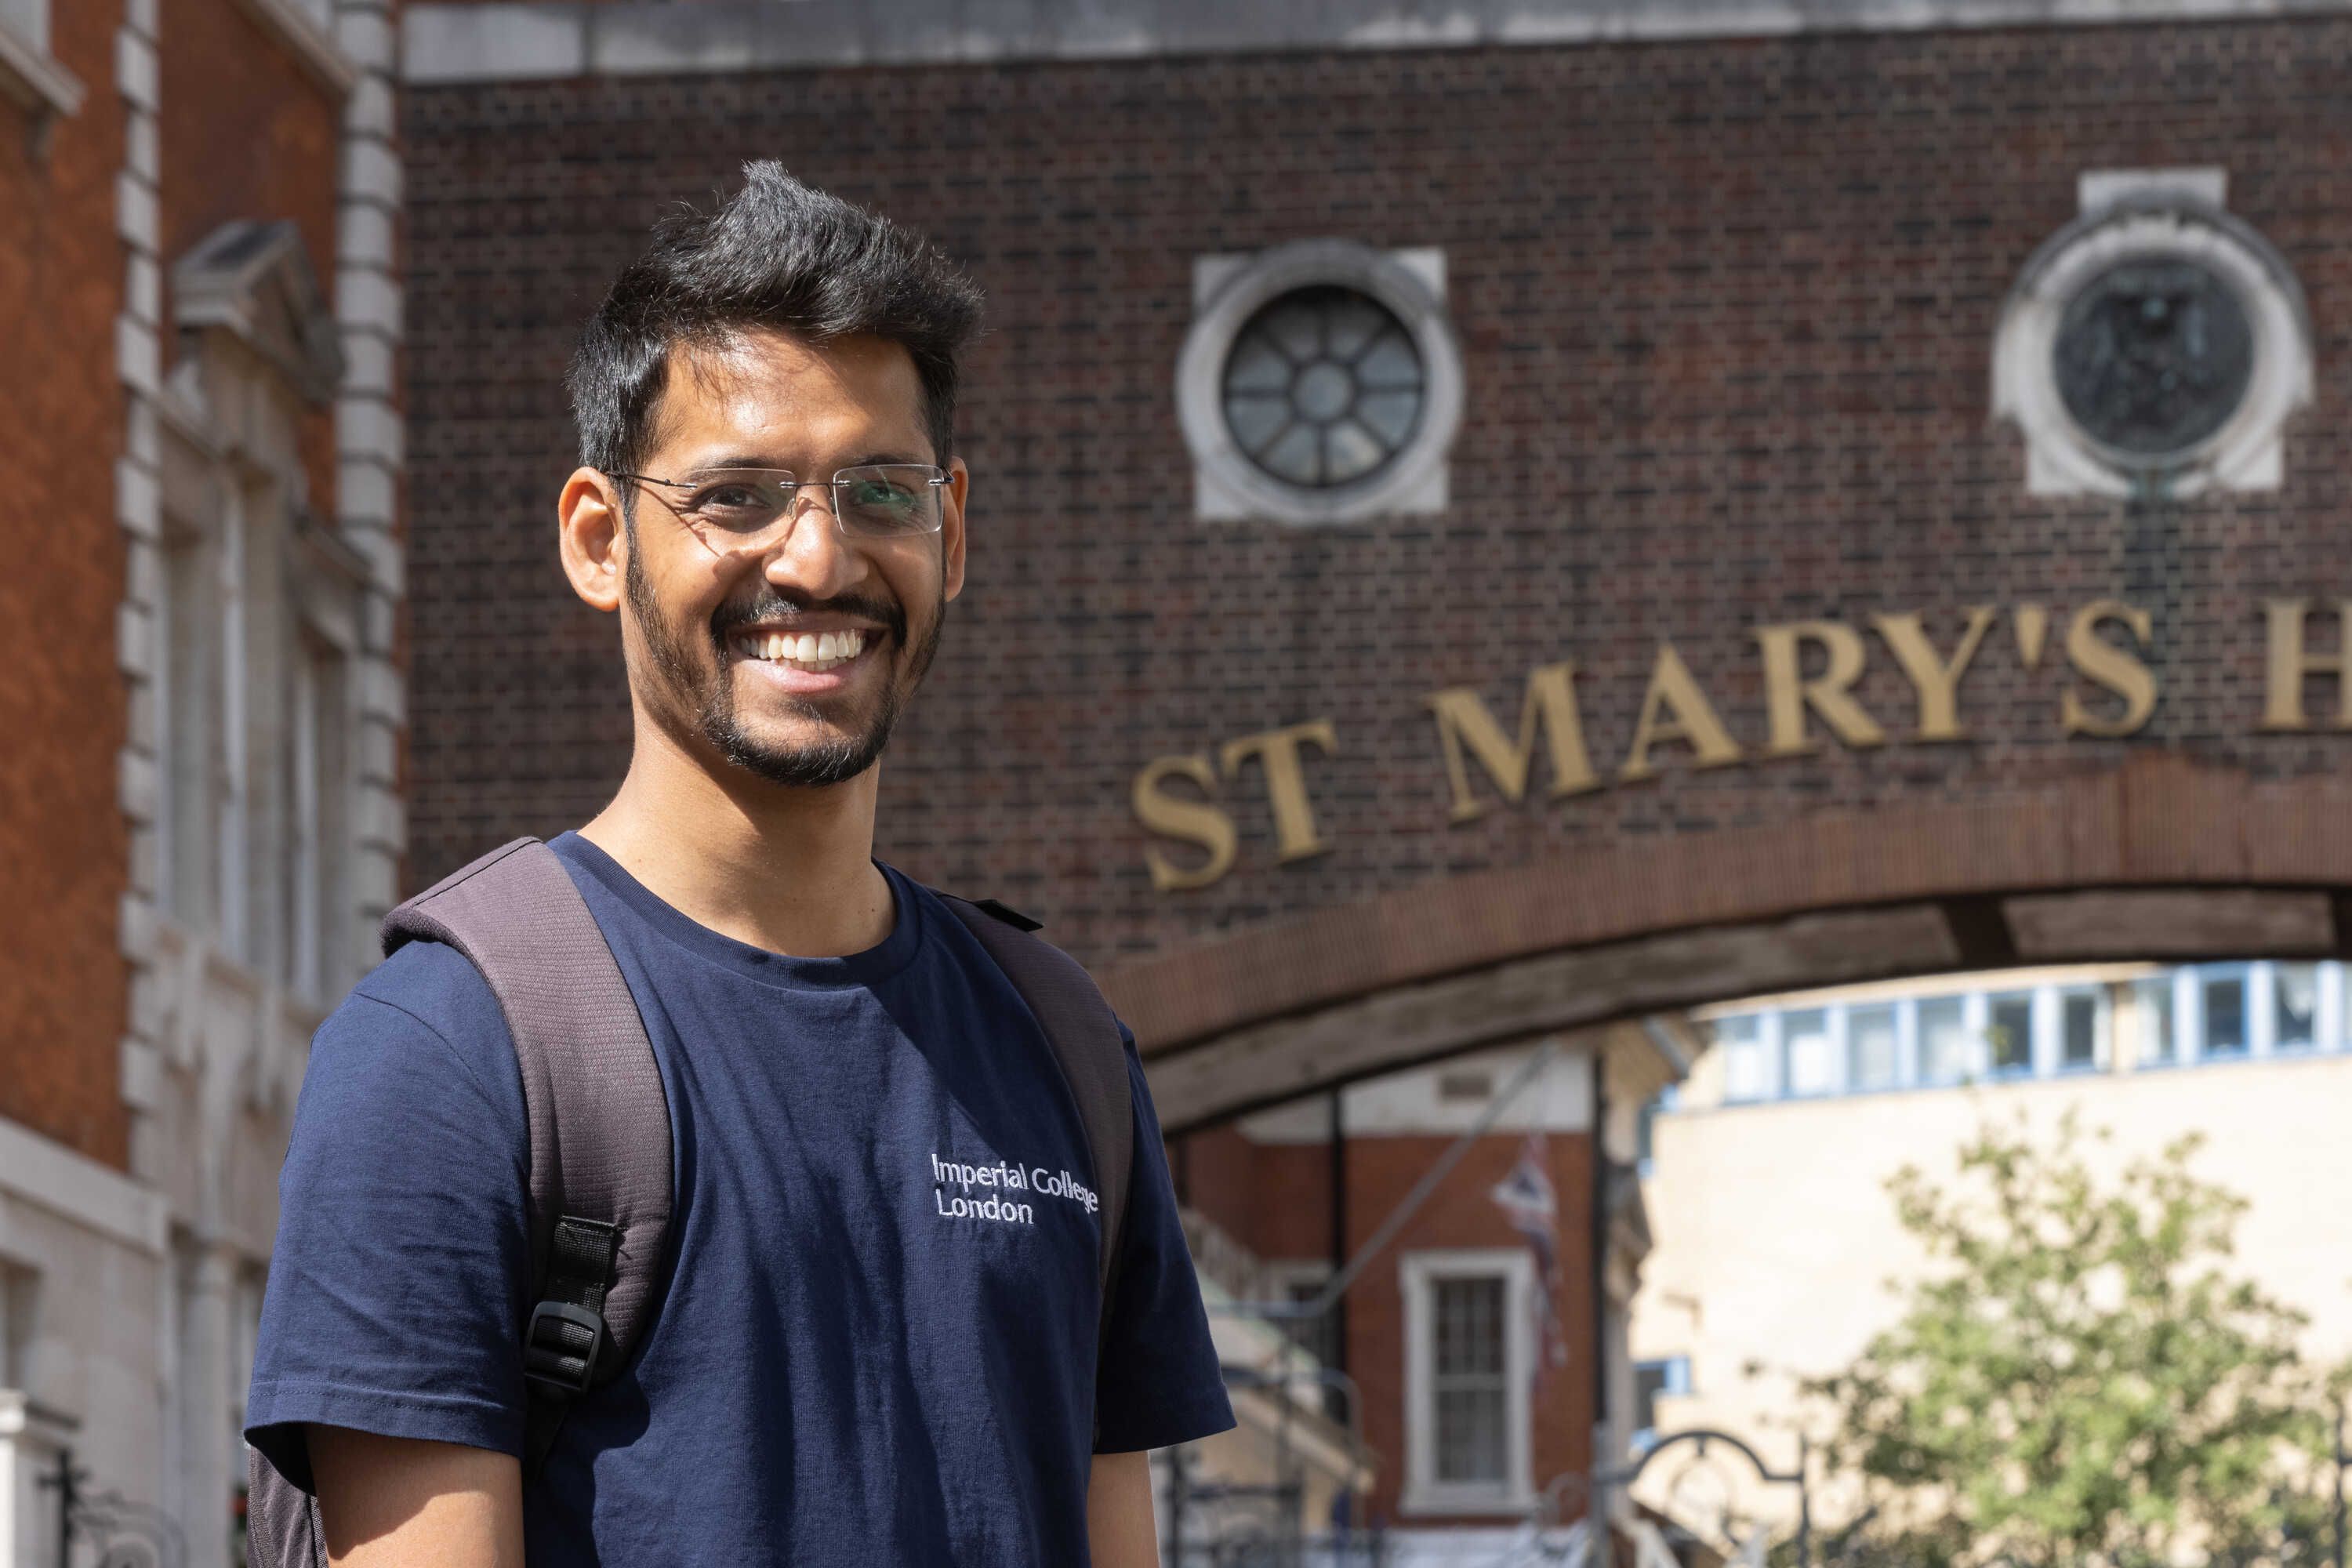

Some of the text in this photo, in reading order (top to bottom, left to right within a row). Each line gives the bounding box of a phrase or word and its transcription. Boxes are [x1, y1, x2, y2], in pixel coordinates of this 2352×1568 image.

[1131, 717, 1337, 891] ST
[1427, 599, 2158, 822] MARY'S
[931, 1153, 1098, 1213] Imperial College
[935, 1189, 1034, 1225] London
